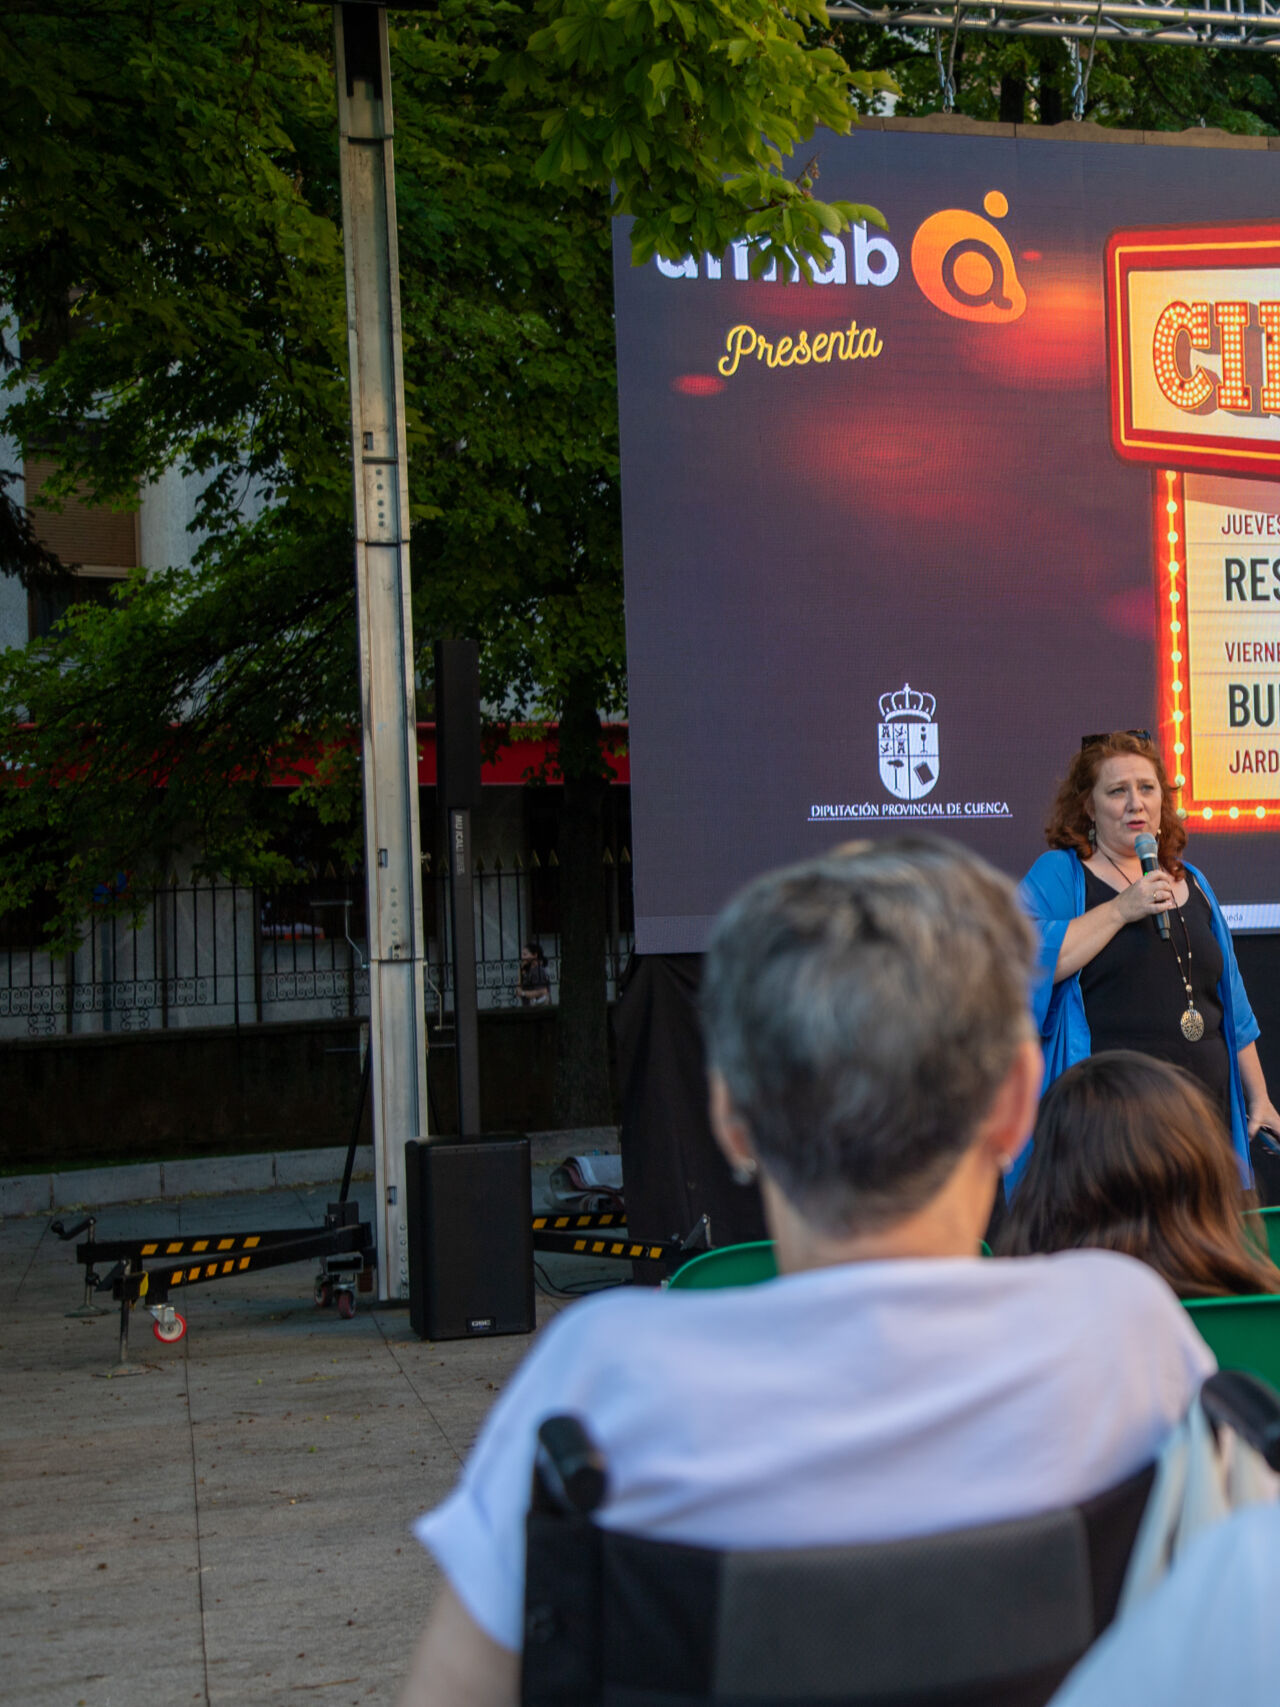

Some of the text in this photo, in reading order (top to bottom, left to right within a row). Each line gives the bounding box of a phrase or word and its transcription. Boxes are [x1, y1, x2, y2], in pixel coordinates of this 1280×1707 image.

[717, 320, 884, 377] Presenta
[811, 801, 1010, 818] DIPUTACIÓN PROVINCIAL DE CUENCA
